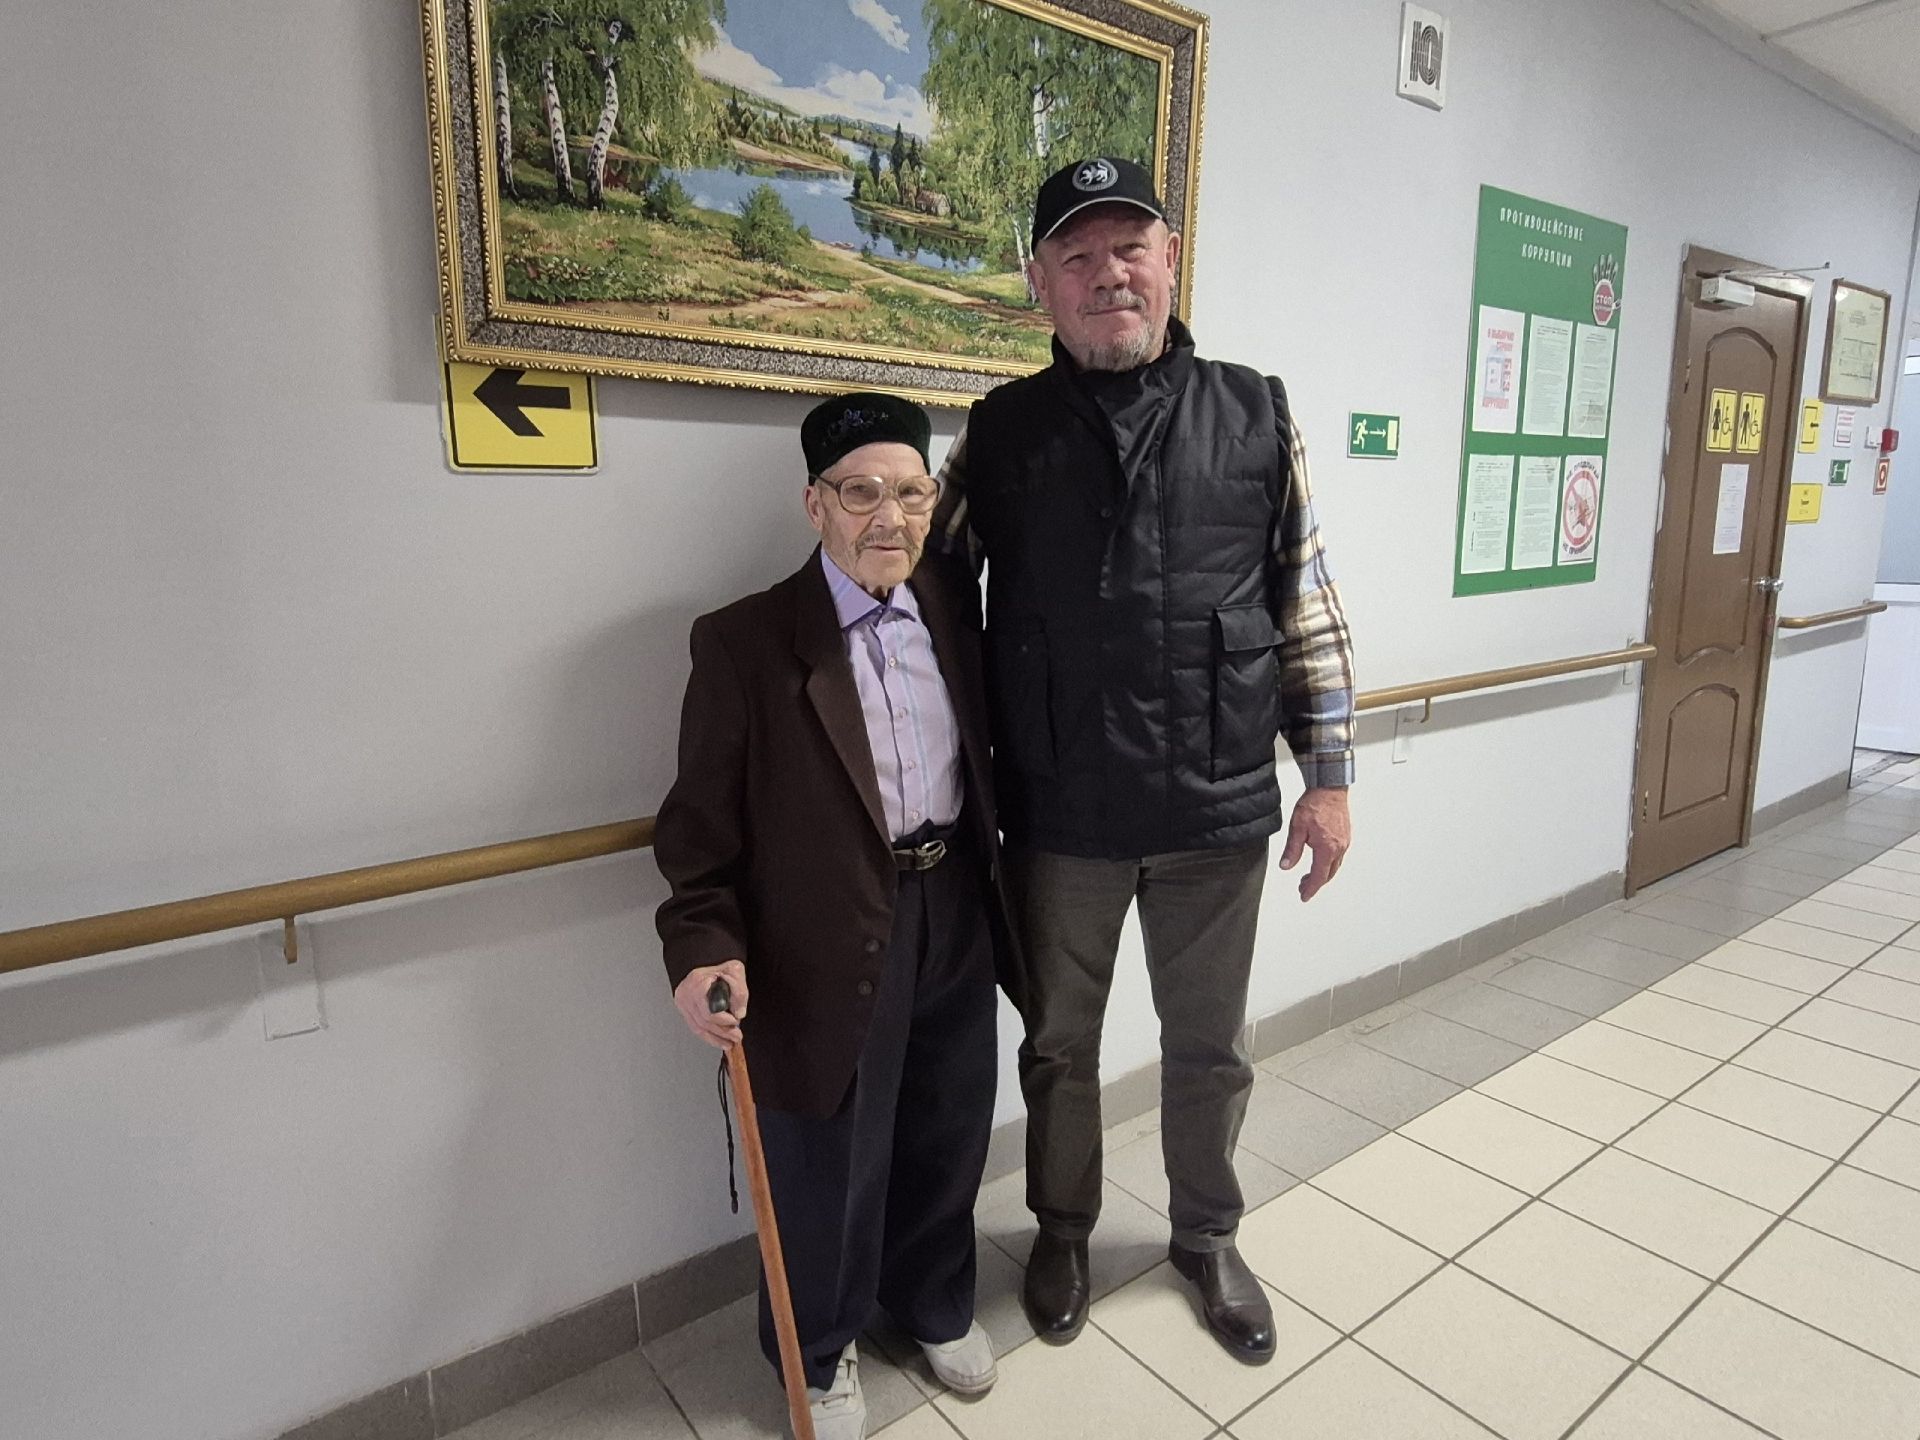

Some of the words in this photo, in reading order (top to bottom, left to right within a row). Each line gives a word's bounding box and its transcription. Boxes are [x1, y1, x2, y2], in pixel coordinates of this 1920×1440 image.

[1500, 207, 1584, 241] ПРОТИВОДЕЙСТВИЕ
[1521, 243, 1572, 268] КОРРУПЦИИ
[1596, 294, 1613, 305] СТОП
